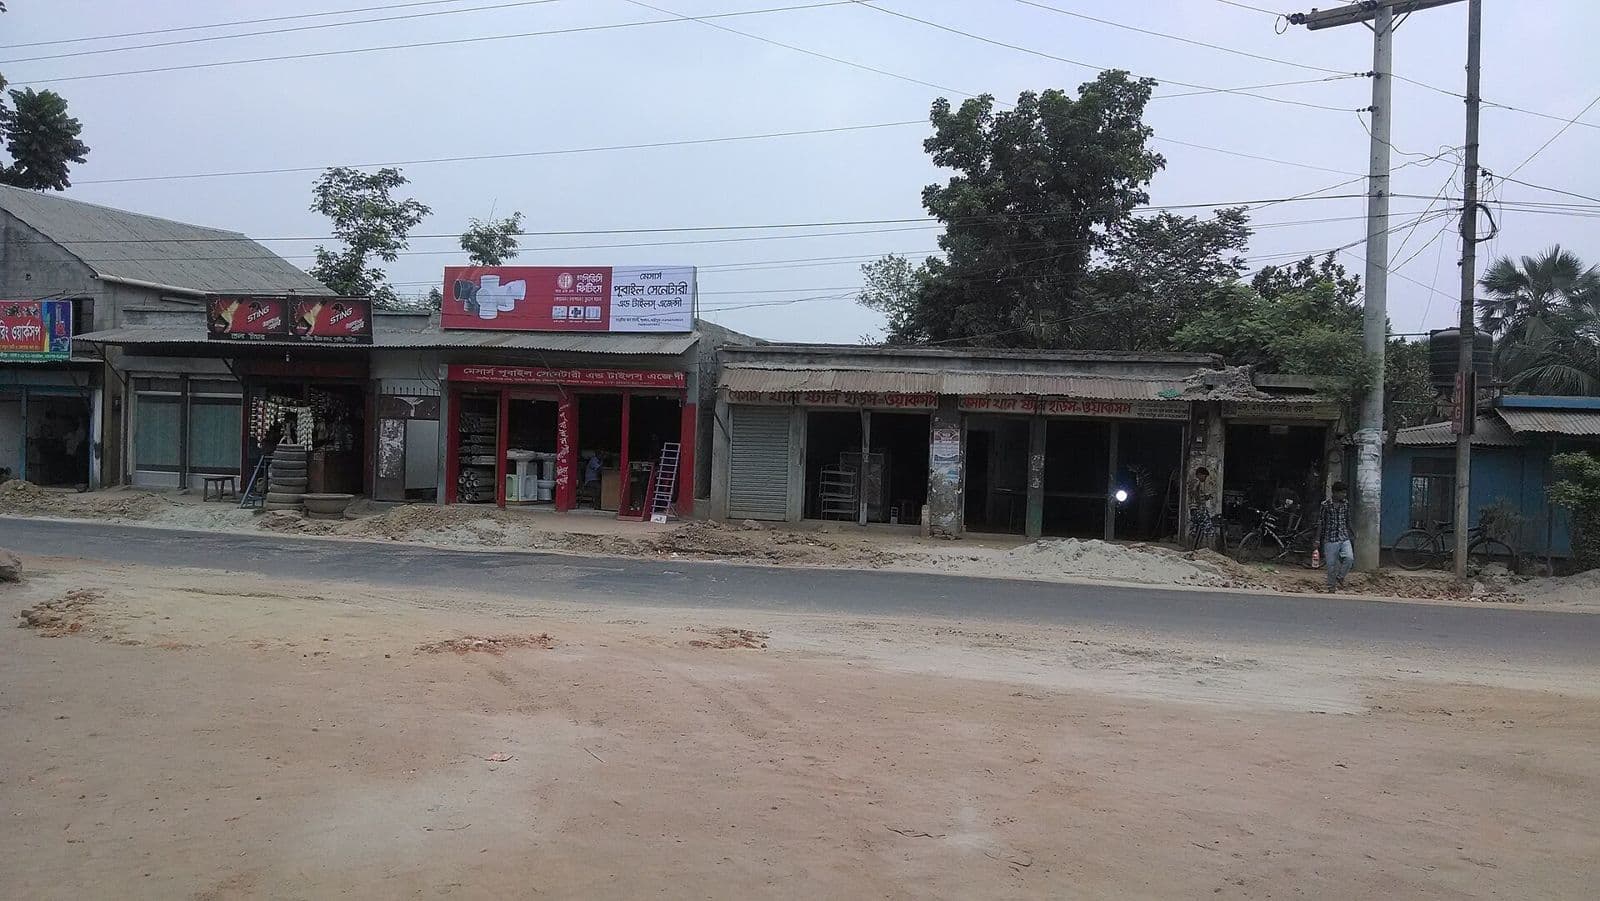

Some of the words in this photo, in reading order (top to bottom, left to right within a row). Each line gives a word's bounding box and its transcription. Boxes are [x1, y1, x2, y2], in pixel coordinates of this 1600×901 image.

[640, 272, 662, 280] মেসার্স
[614, 283, 645, 297] পূবাইল
[647, 281, 688, 295] সেনেটারী
[247, 305, 270, 323] STING
[329, 307, 353, 325] STING
